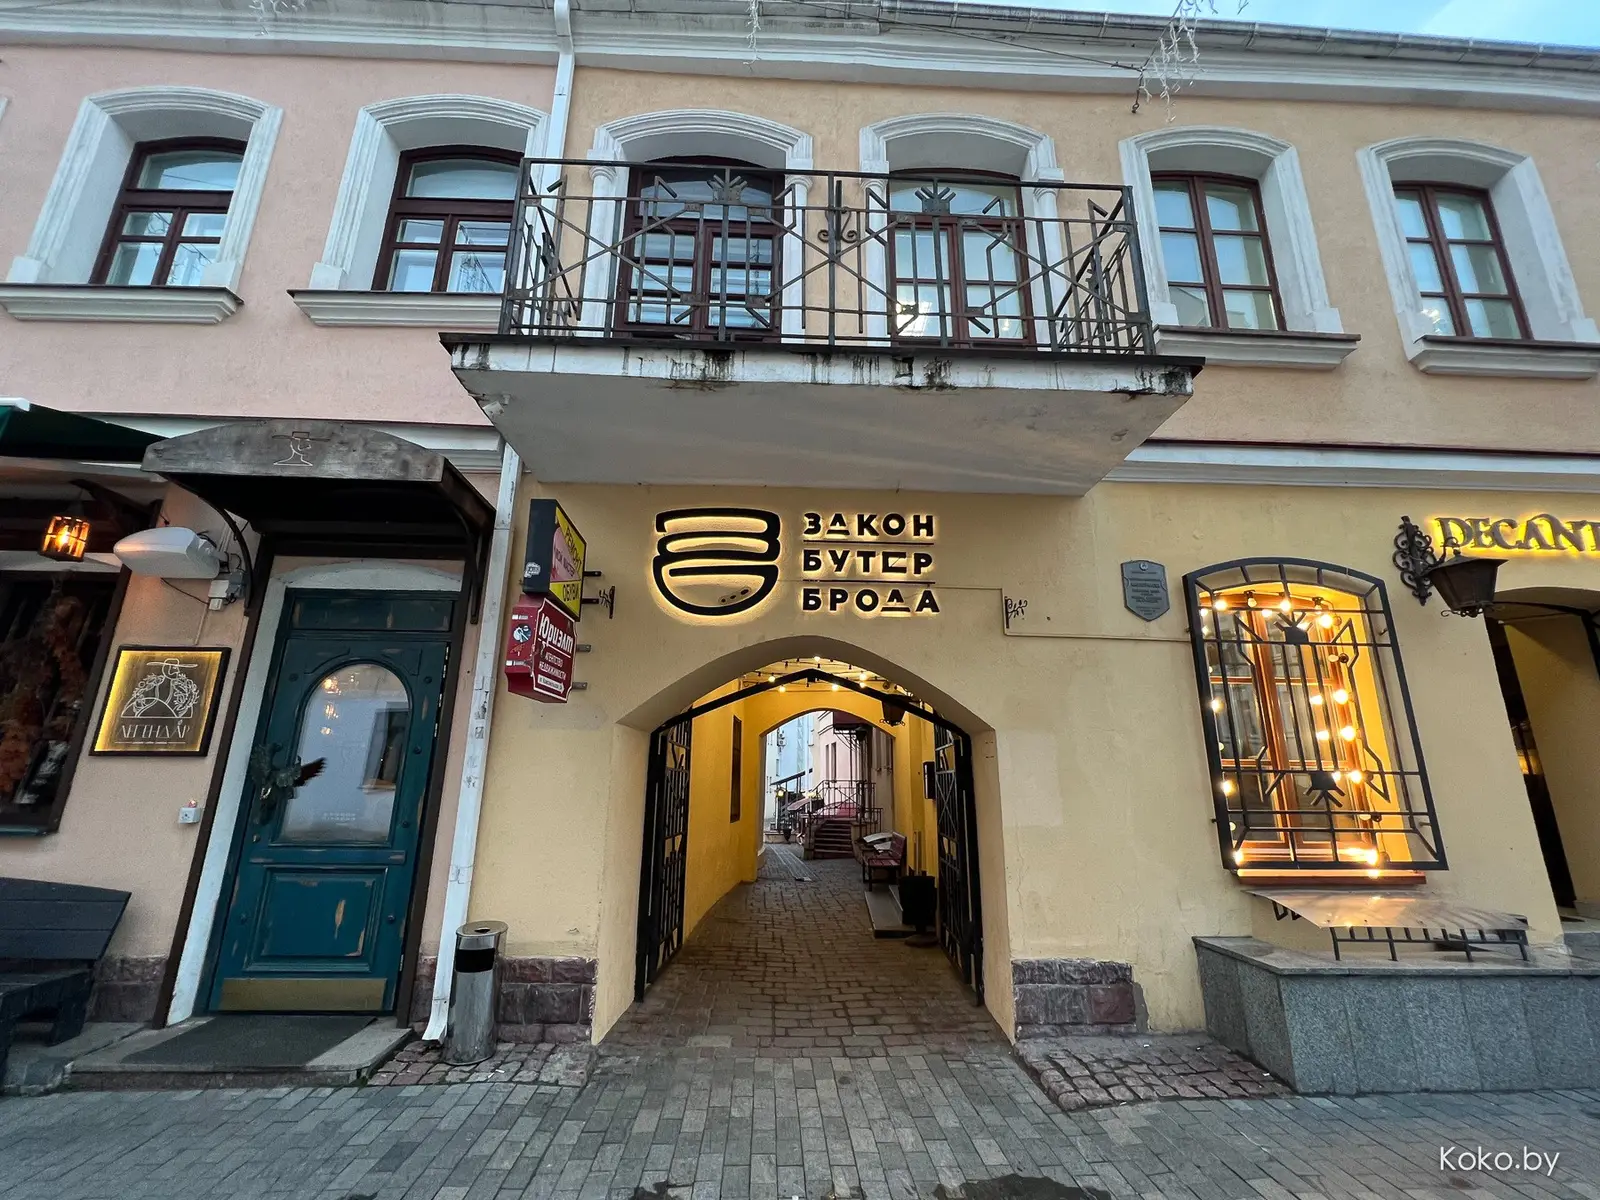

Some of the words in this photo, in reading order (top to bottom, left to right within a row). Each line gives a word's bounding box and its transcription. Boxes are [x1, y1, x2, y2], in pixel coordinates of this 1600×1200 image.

[803, 512, 934, 537] ЗАКОН
[803, 549, 933, 575] БУТЕР
[802, 588, 940, 613] БРОДА
